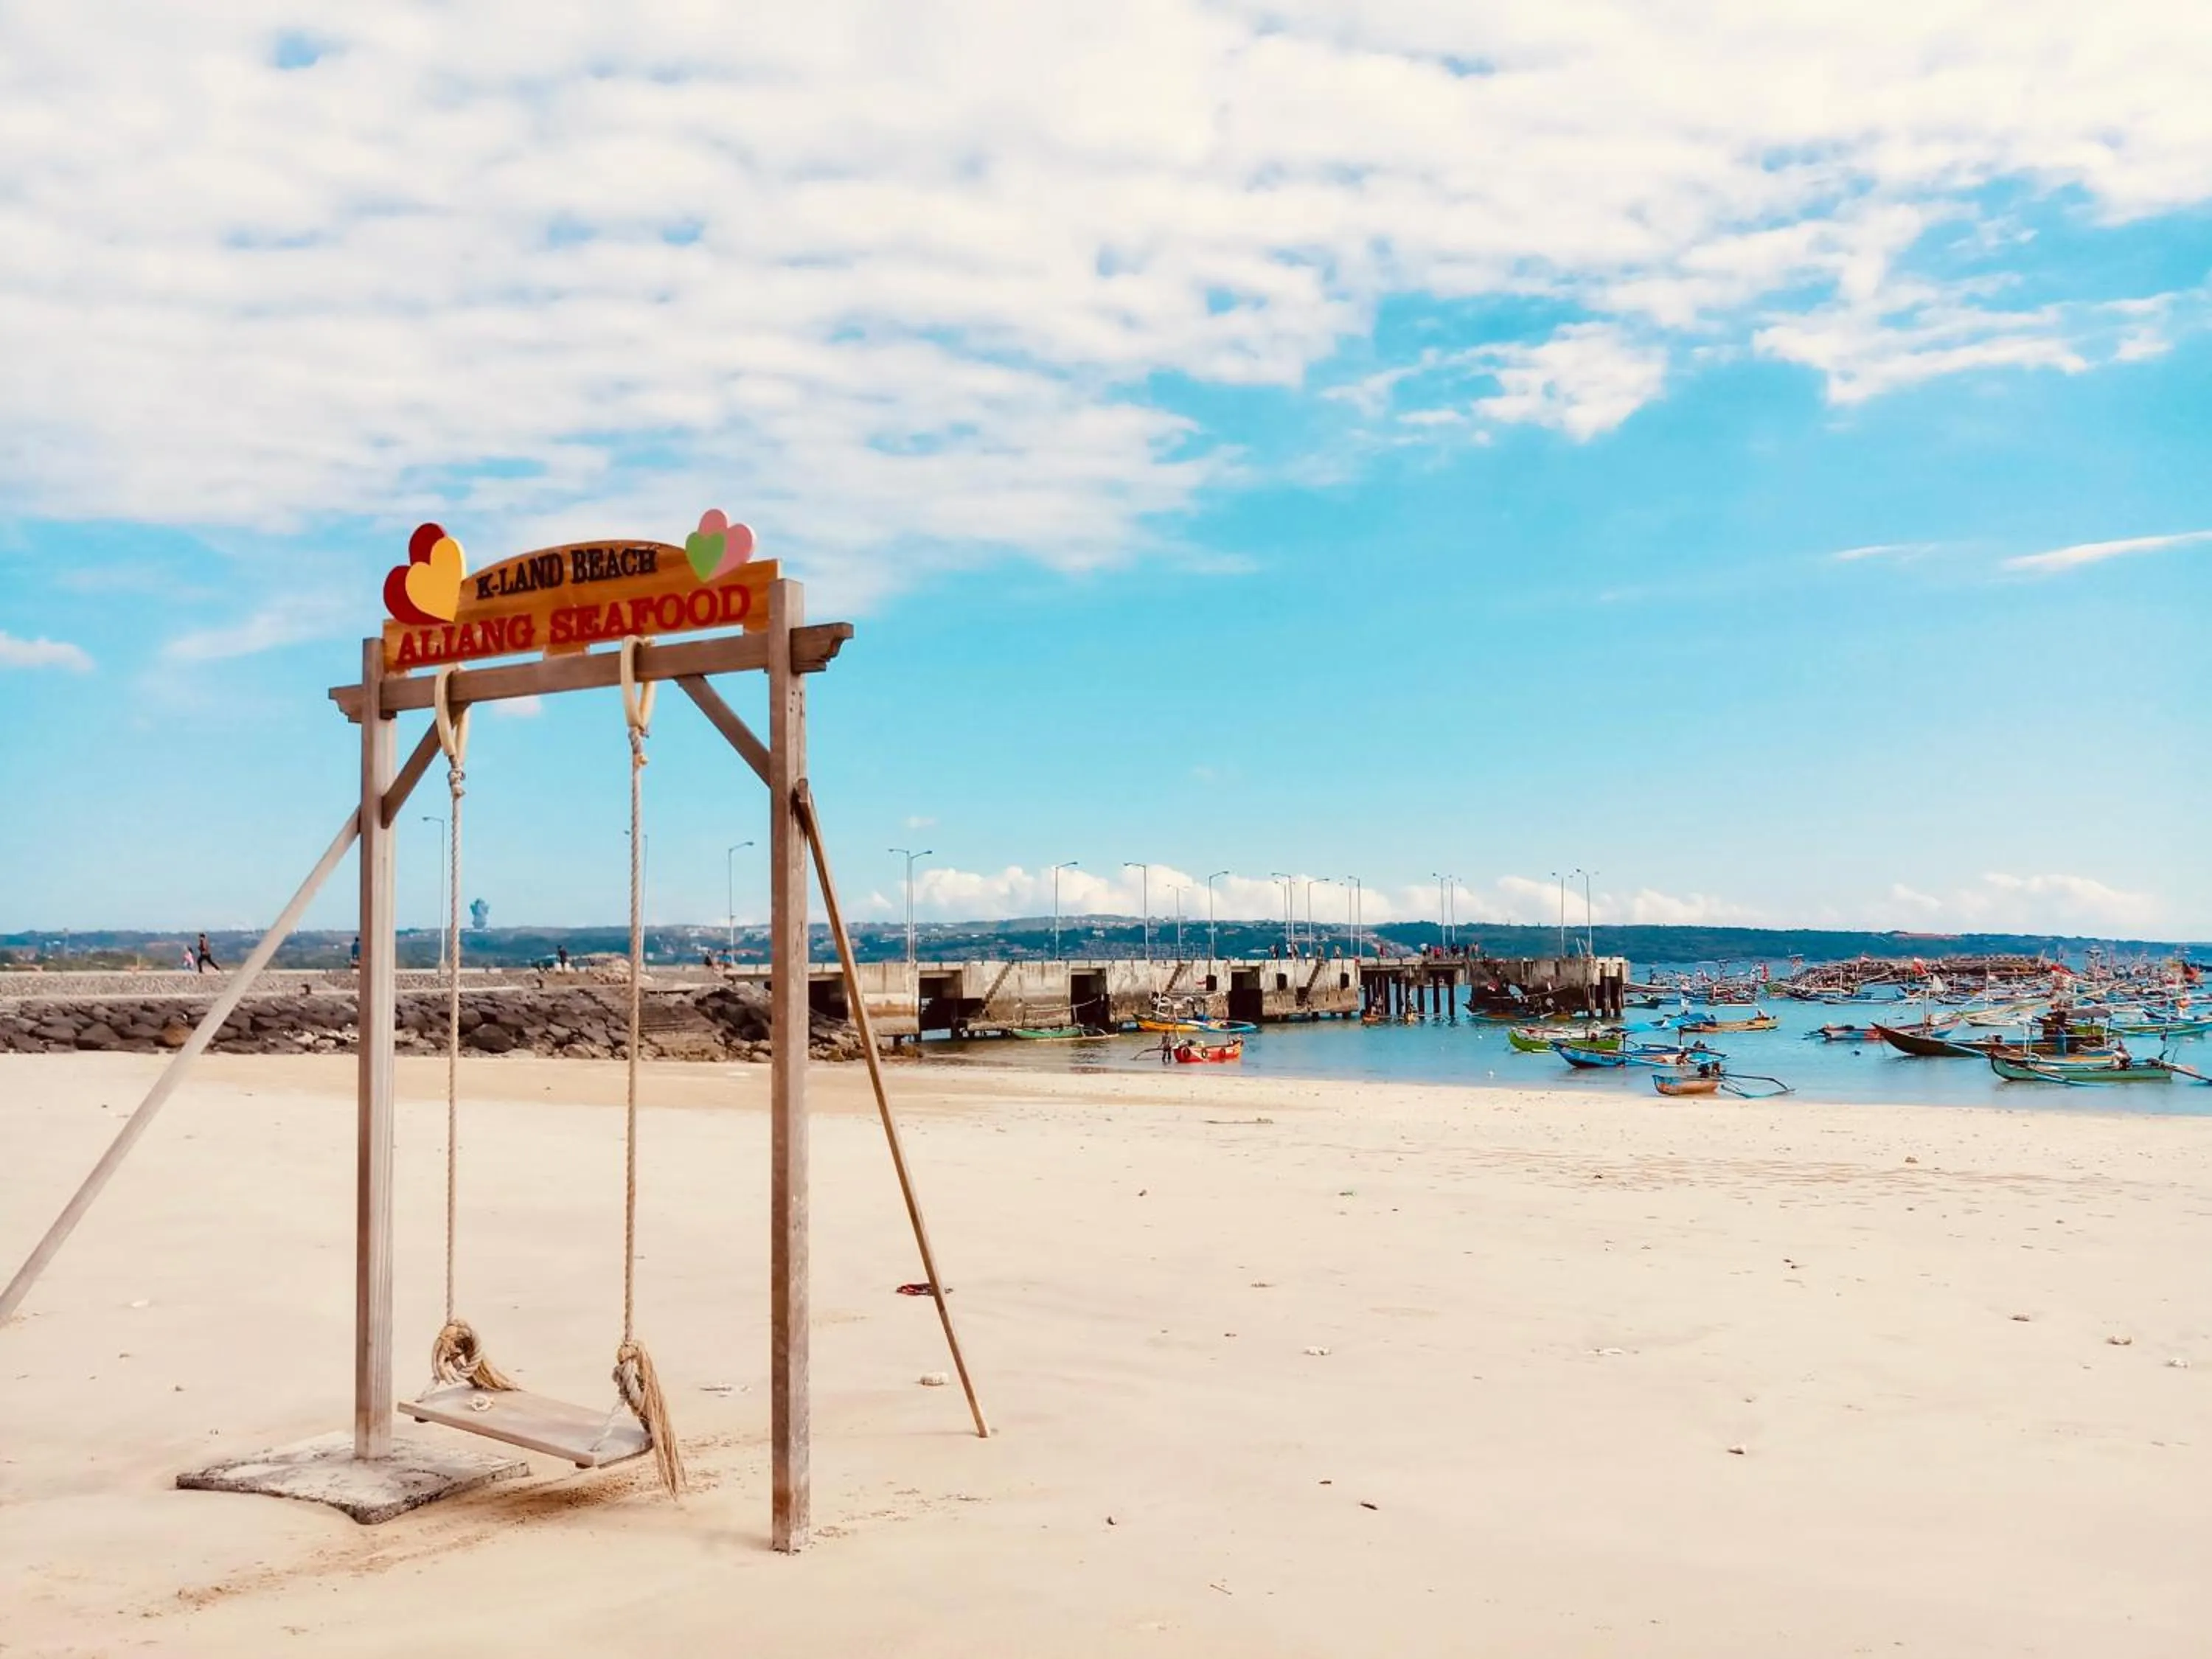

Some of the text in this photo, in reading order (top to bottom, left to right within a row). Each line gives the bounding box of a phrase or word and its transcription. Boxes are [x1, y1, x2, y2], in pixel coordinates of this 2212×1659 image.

[476, 548, 657, 600] K-LAND BEACH
[395, 584, 751, 665] ALIANG SEAFOOD
